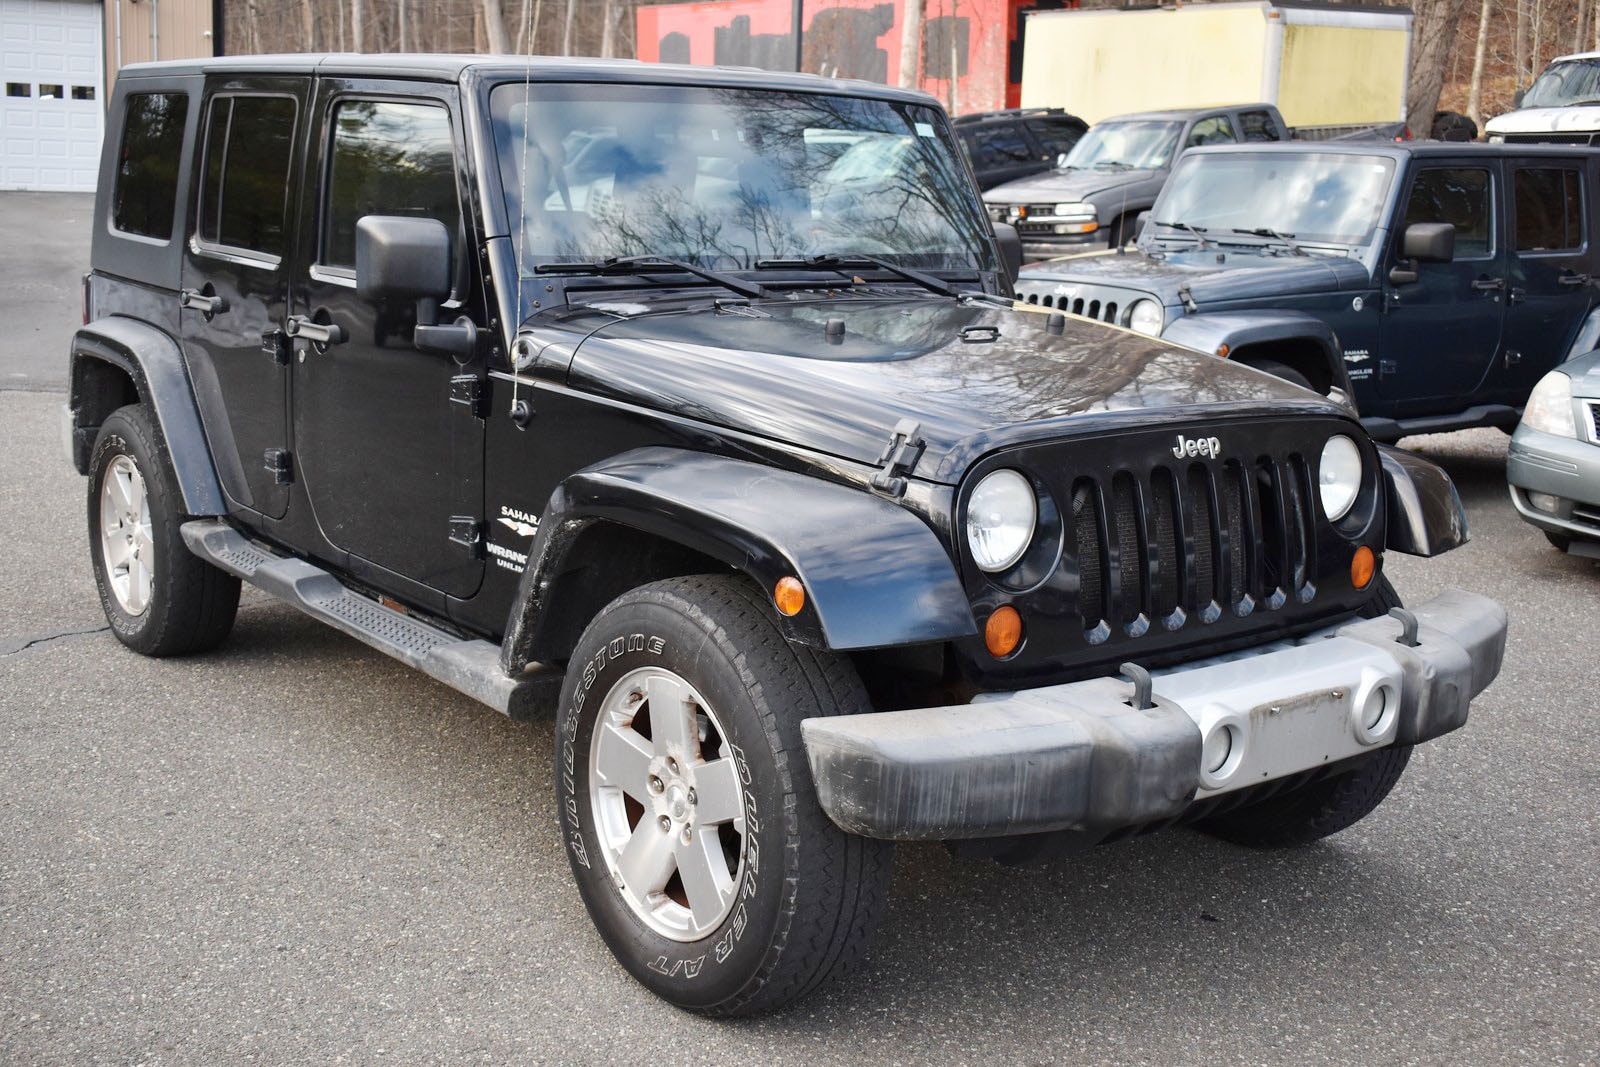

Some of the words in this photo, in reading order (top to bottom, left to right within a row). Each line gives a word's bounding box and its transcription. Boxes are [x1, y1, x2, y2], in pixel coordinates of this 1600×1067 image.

[1172, 434, 1221, 459] Jeep
[563, 633, 666, 870] BRIDGESTONE
[715, 743, 760, 964] DUELER
[646, 955, 706, 979] A/T
